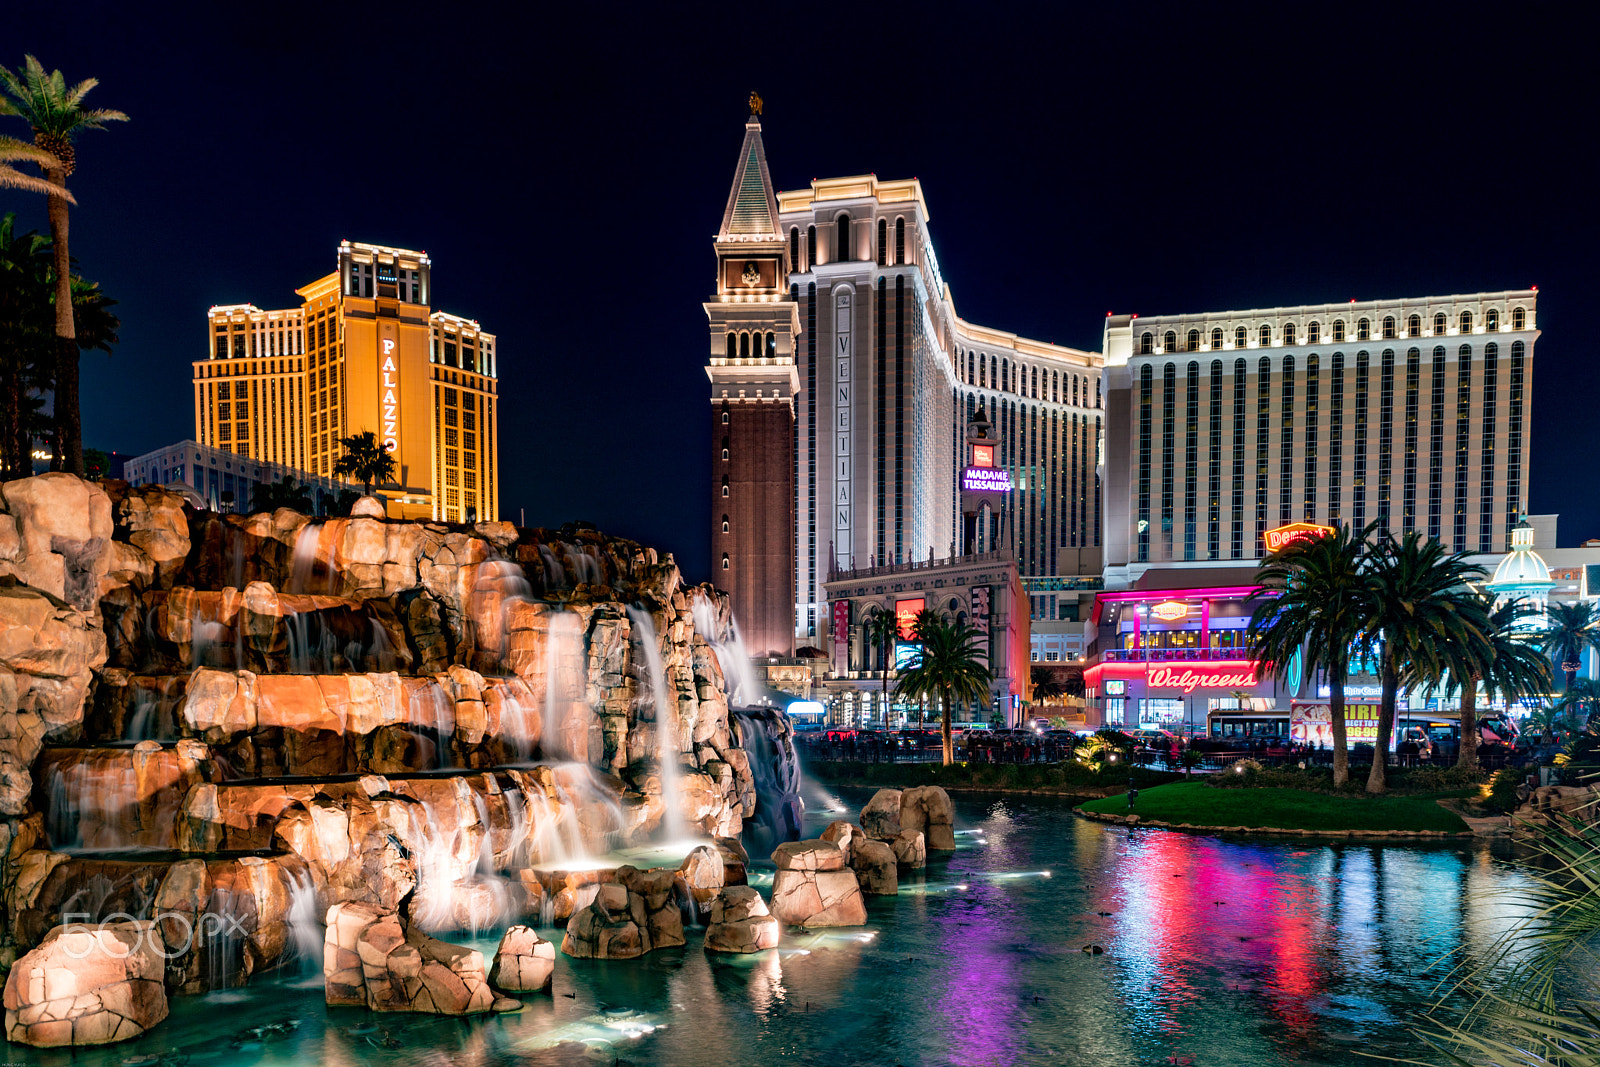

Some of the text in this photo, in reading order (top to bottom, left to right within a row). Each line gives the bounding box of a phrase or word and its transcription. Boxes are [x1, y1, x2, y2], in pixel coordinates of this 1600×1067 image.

[382, 338, 398, 453] PALAZZO
[838, 336, 849, 525] VENETIAN
[966, 469, 1009, 481] MADAME
[1148, 668, 1258, 694] Walgreens
